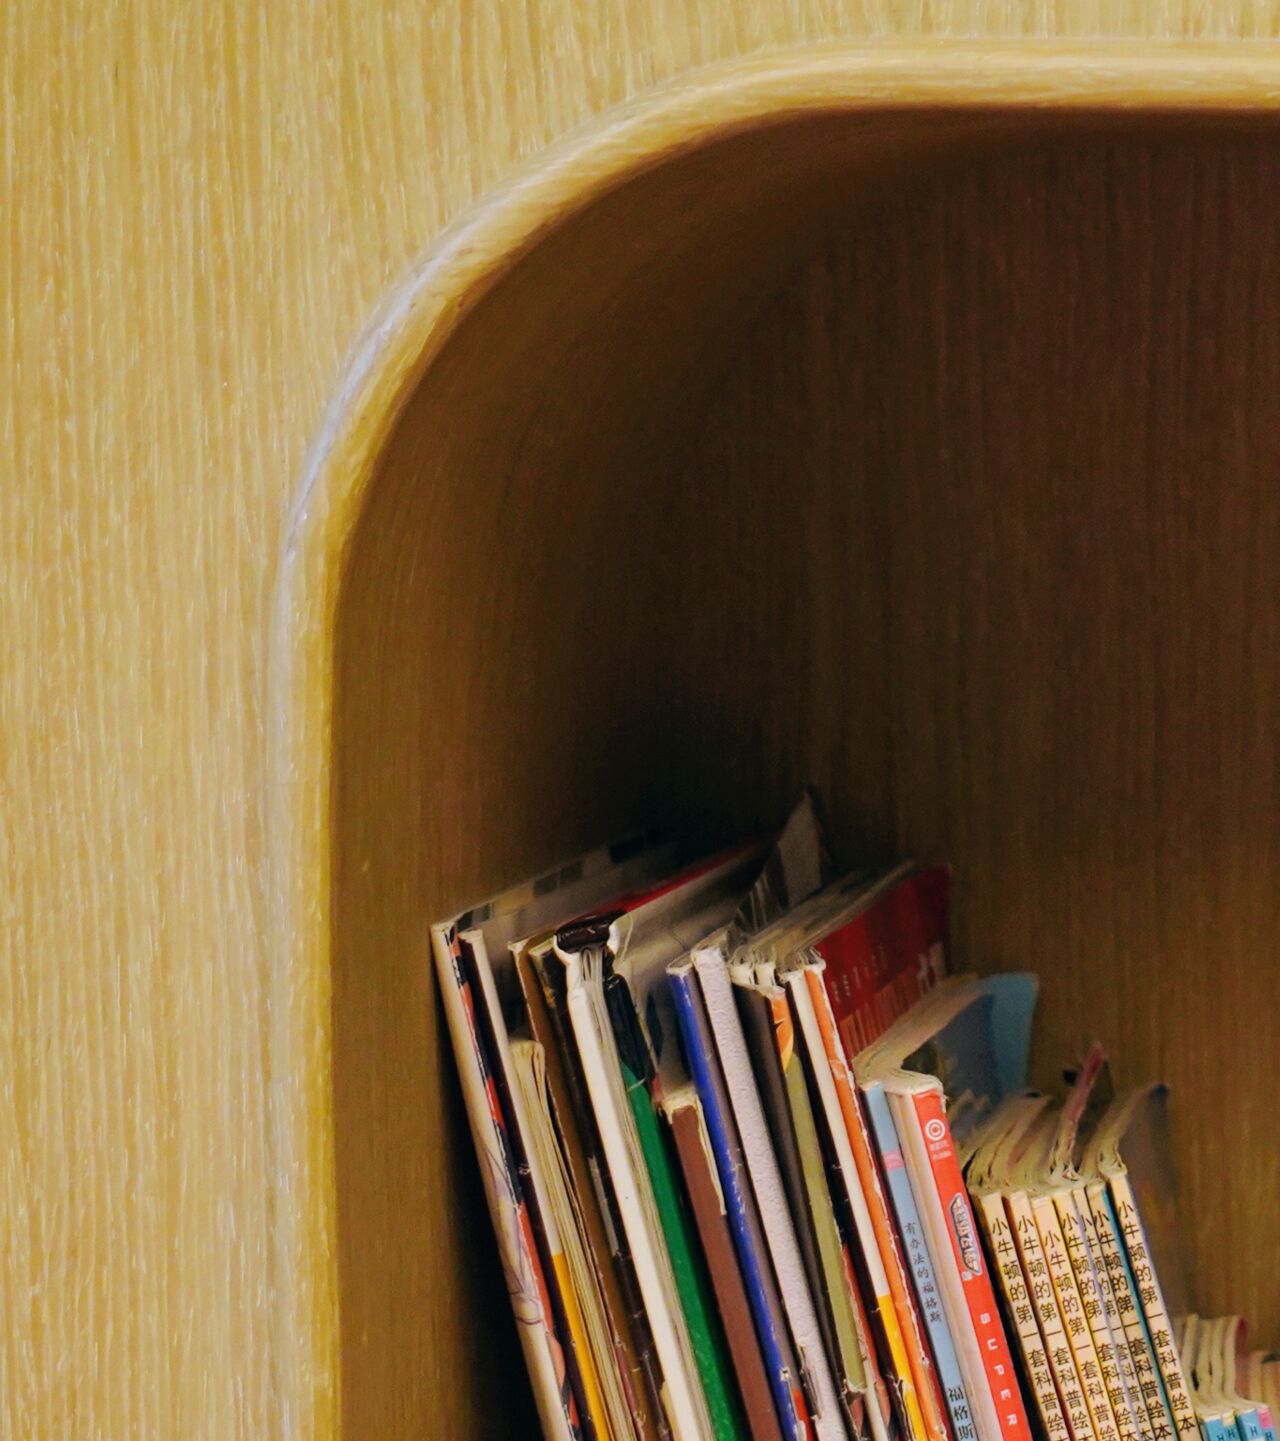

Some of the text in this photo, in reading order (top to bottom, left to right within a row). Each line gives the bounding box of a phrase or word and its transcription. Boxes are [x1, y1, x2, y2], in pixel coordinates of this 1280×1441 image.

[904, 1221, 942, 1323] 有办法的福格斯
[1094, 1210, 1172, 1440] 小牛顿的第一套科普绘本
[1118, 1201, 1195, 1433] 小牛顿的第一套科普绘本
[980, 1313, 1018, 1426] SUPER
